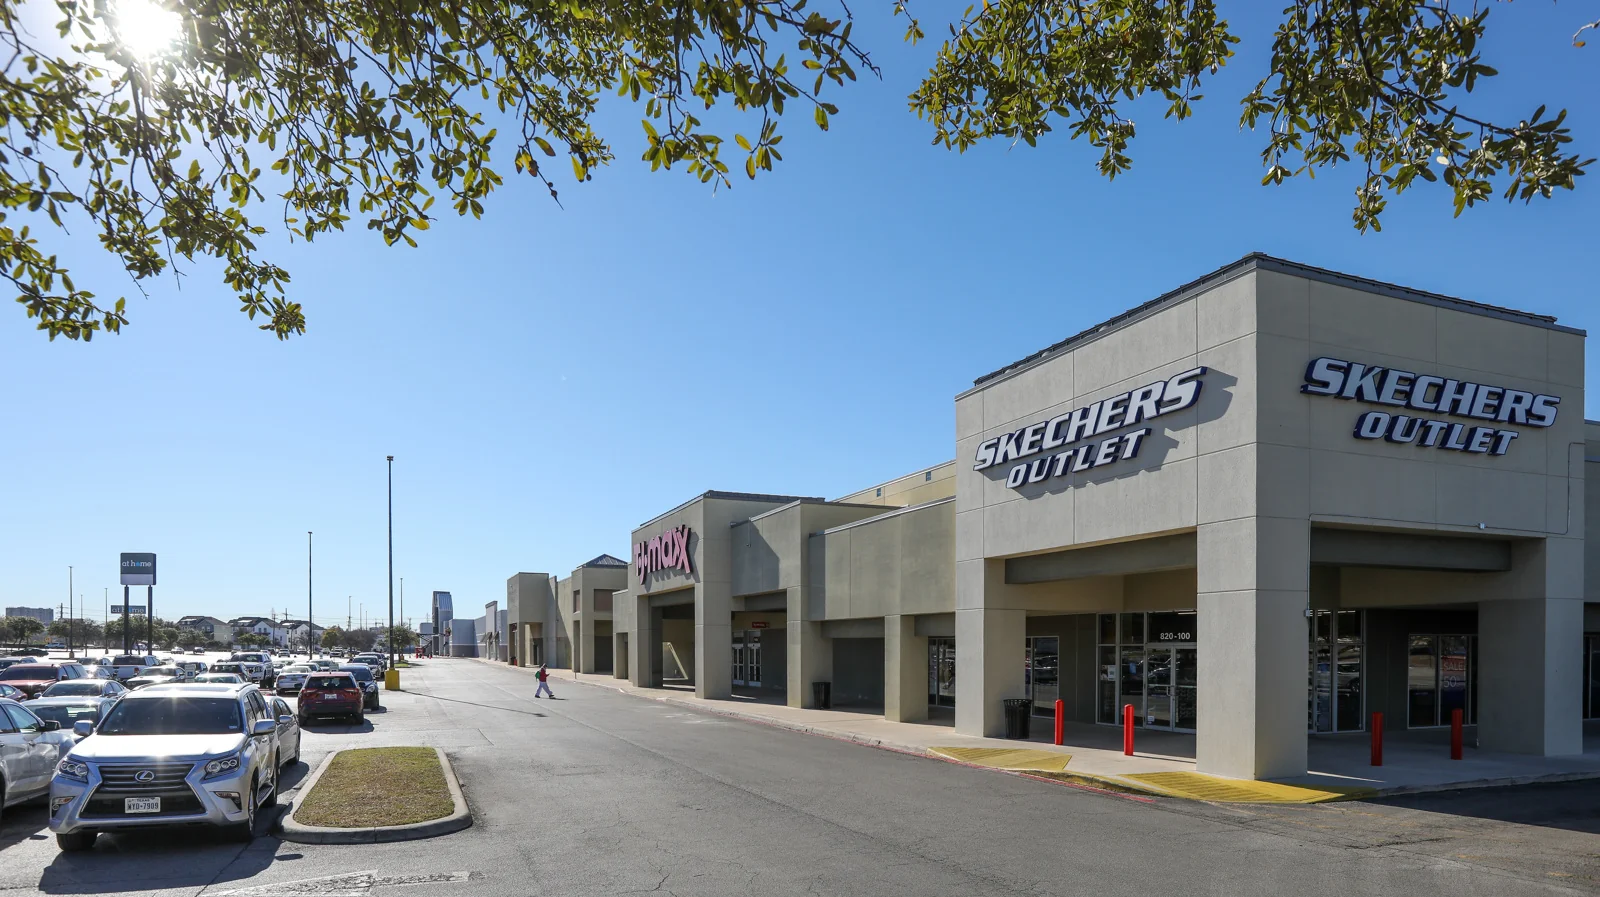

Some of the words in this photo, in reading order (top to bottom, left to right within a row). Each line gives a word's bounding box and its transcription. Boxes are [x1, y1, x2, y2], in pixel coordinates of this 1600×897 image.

[973, 366, 1208, 471] SKECHERS
[1301, 357, 1561, 428] SKECHERS
[1006, 428, 1151, 489] OUTLET
[1353, 411, 1519, 456] OUTLET
[1160, 632, 1191, 640] 820-100
[1443, 661, 1464, 671] SALE
